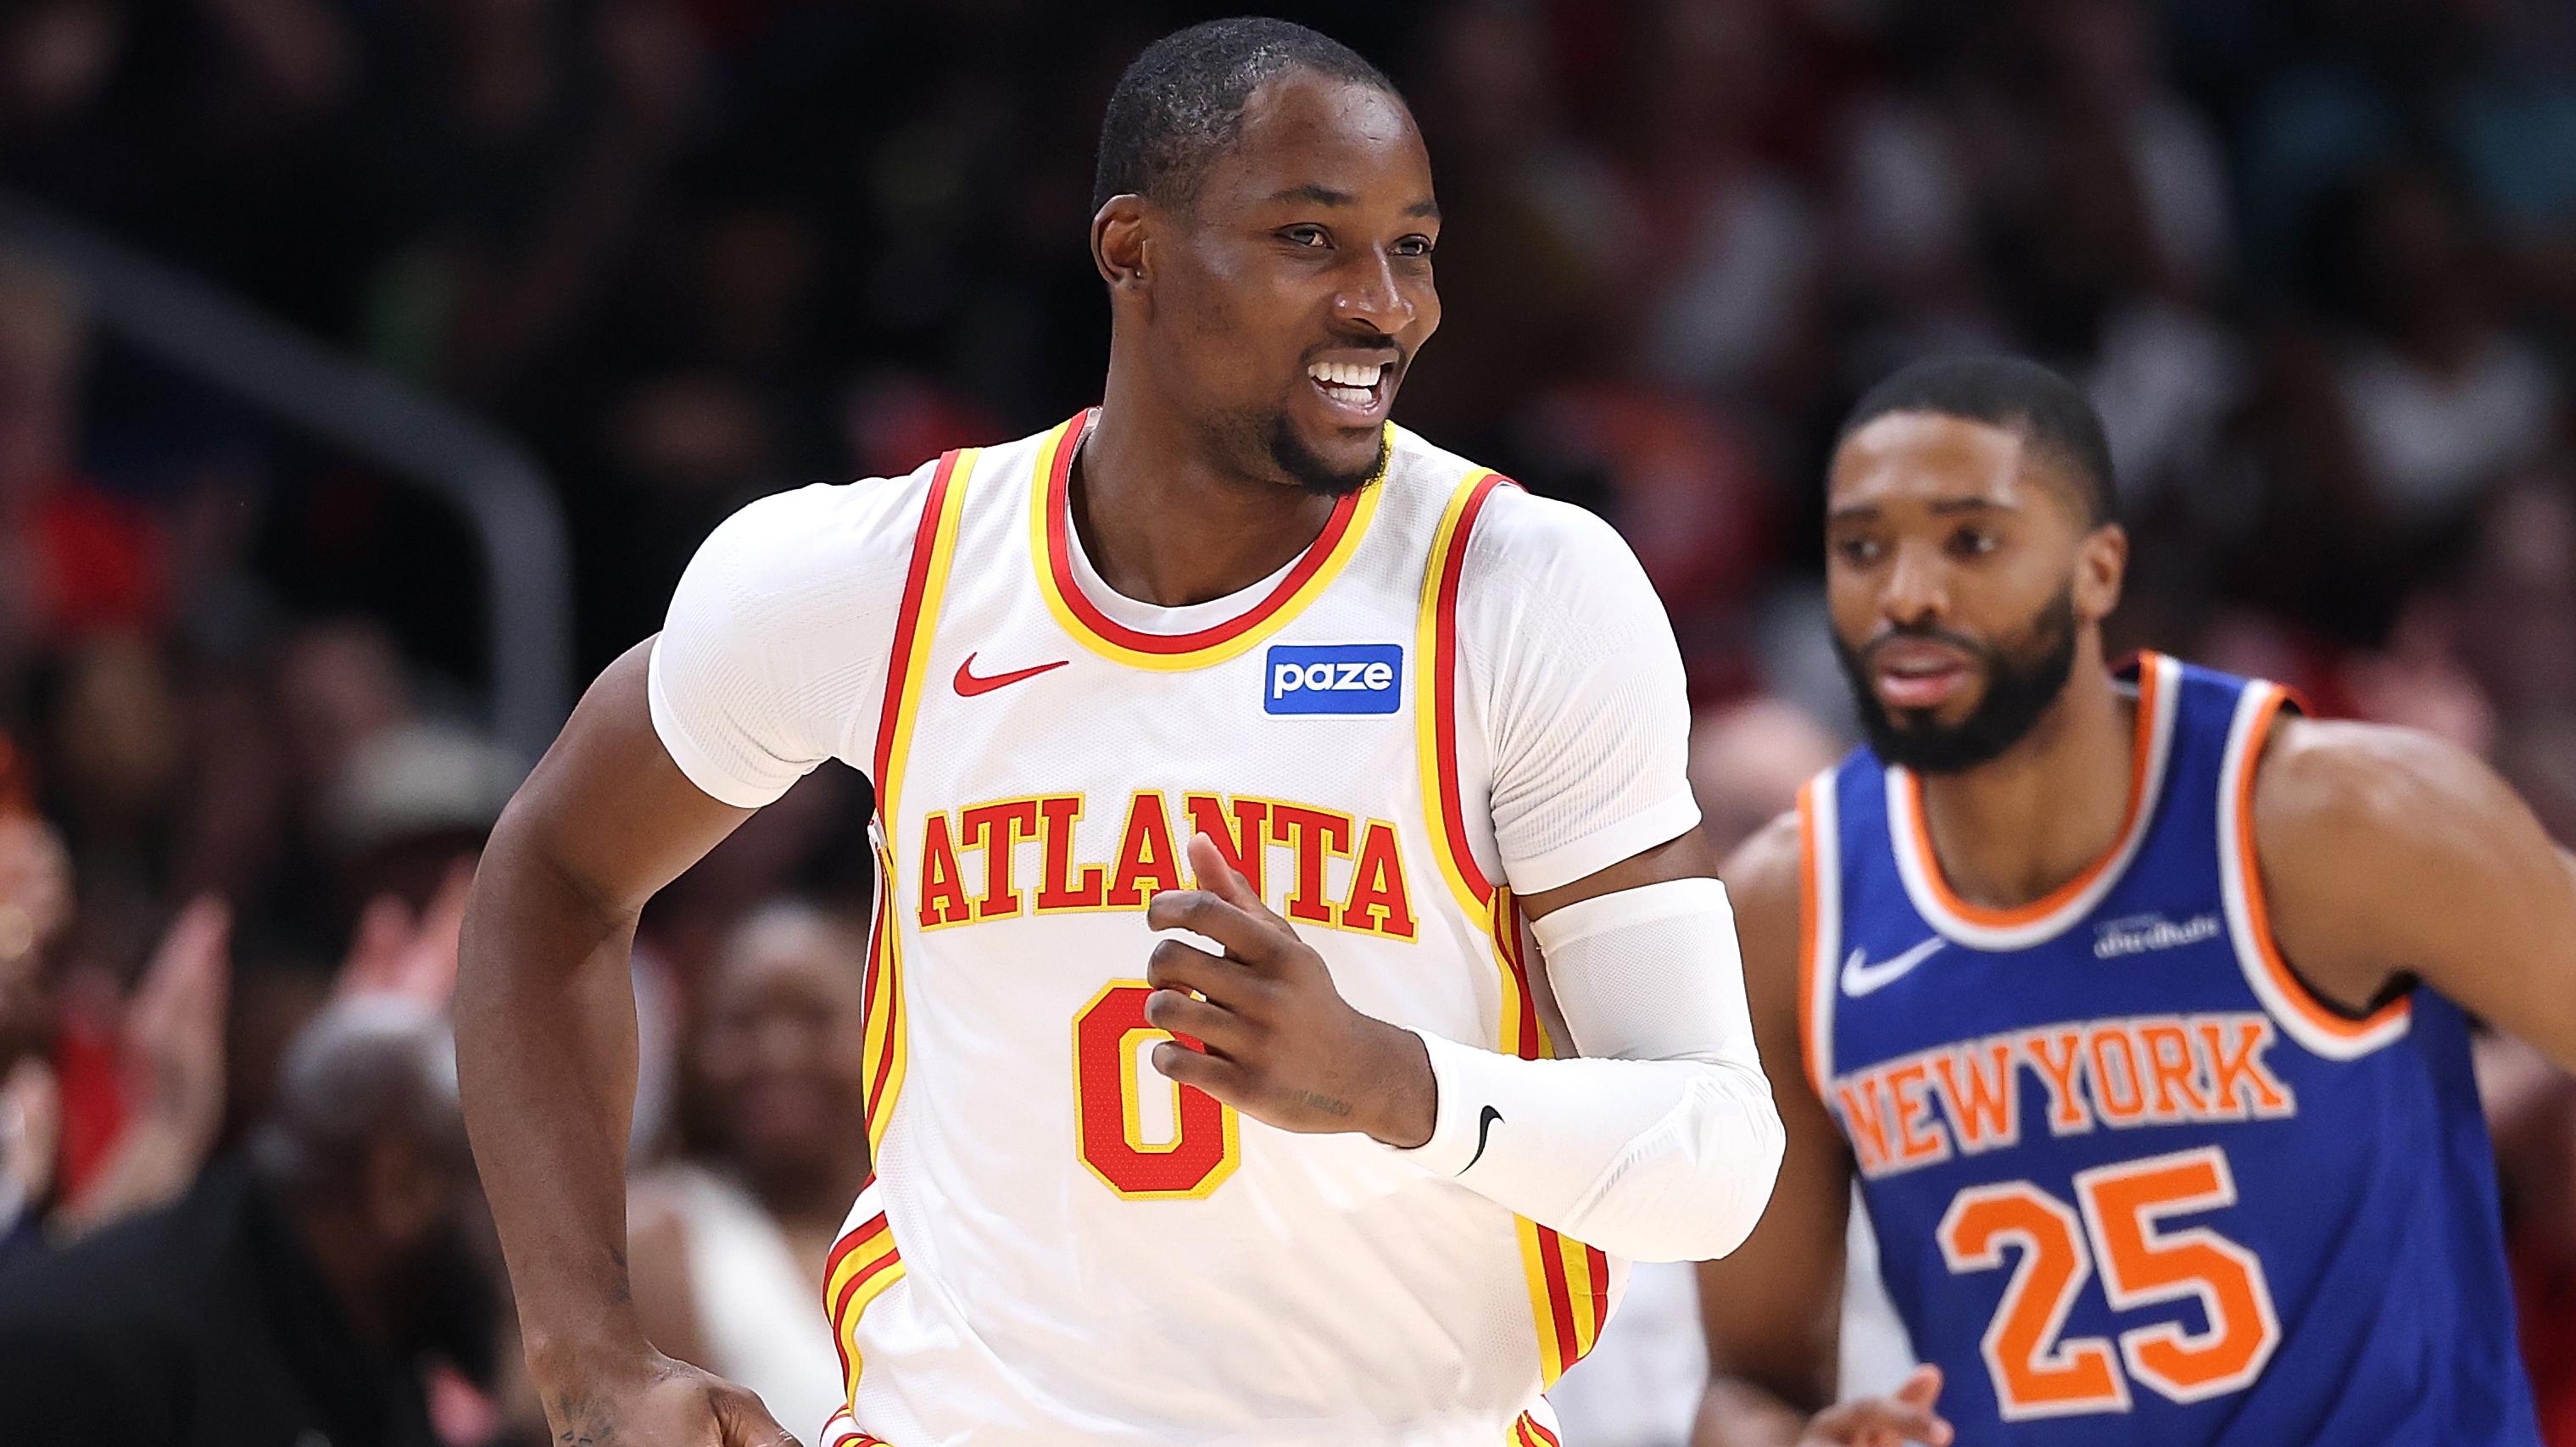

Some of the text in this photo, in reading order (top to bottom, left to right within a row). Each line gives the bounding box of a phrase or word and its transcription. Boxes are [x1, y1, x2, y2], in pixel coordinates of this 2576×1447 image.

[1273, 662, 1393, 699] paze
[915, 790, 1419, 943] ATLANTA
[1072, 978, 1241, 1200] 0
[1832, 1013, 2295, 1177] NEW YORK
[1936, 1146, 2282, 1422] 25
